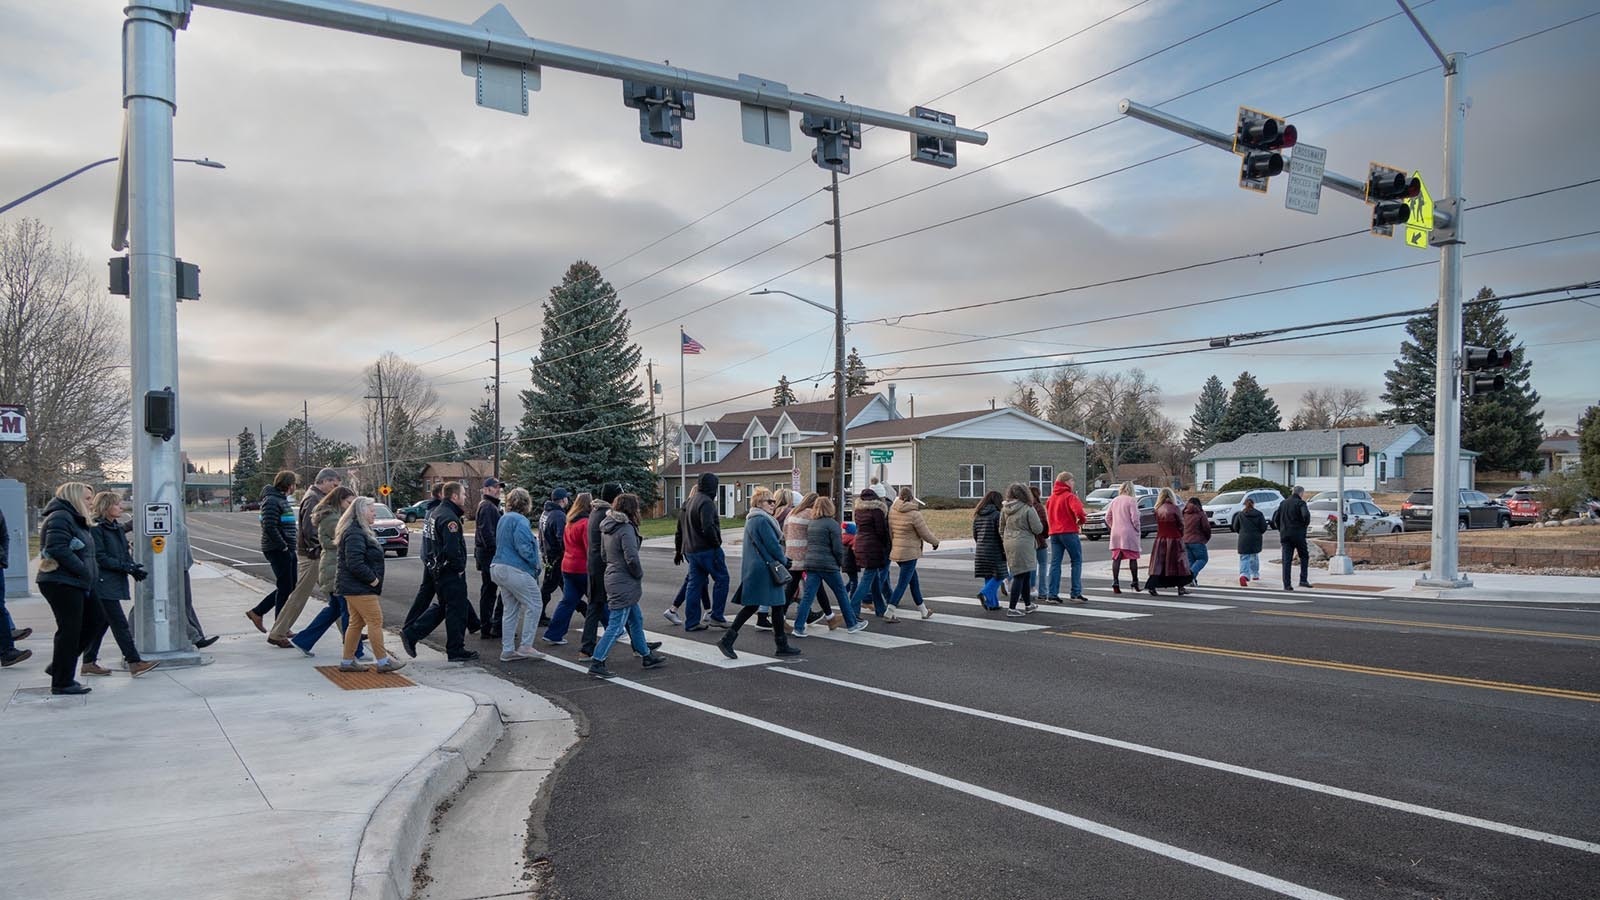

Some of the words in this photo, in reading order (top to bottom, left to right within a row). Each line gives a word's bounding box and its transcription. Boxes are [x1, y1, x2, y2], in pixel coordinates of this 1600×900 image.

[1294, 145, 1324, 161] CROSSWALK
[1292, 161, 1304, 172] STOP
[1, 416, 21, 434] M
